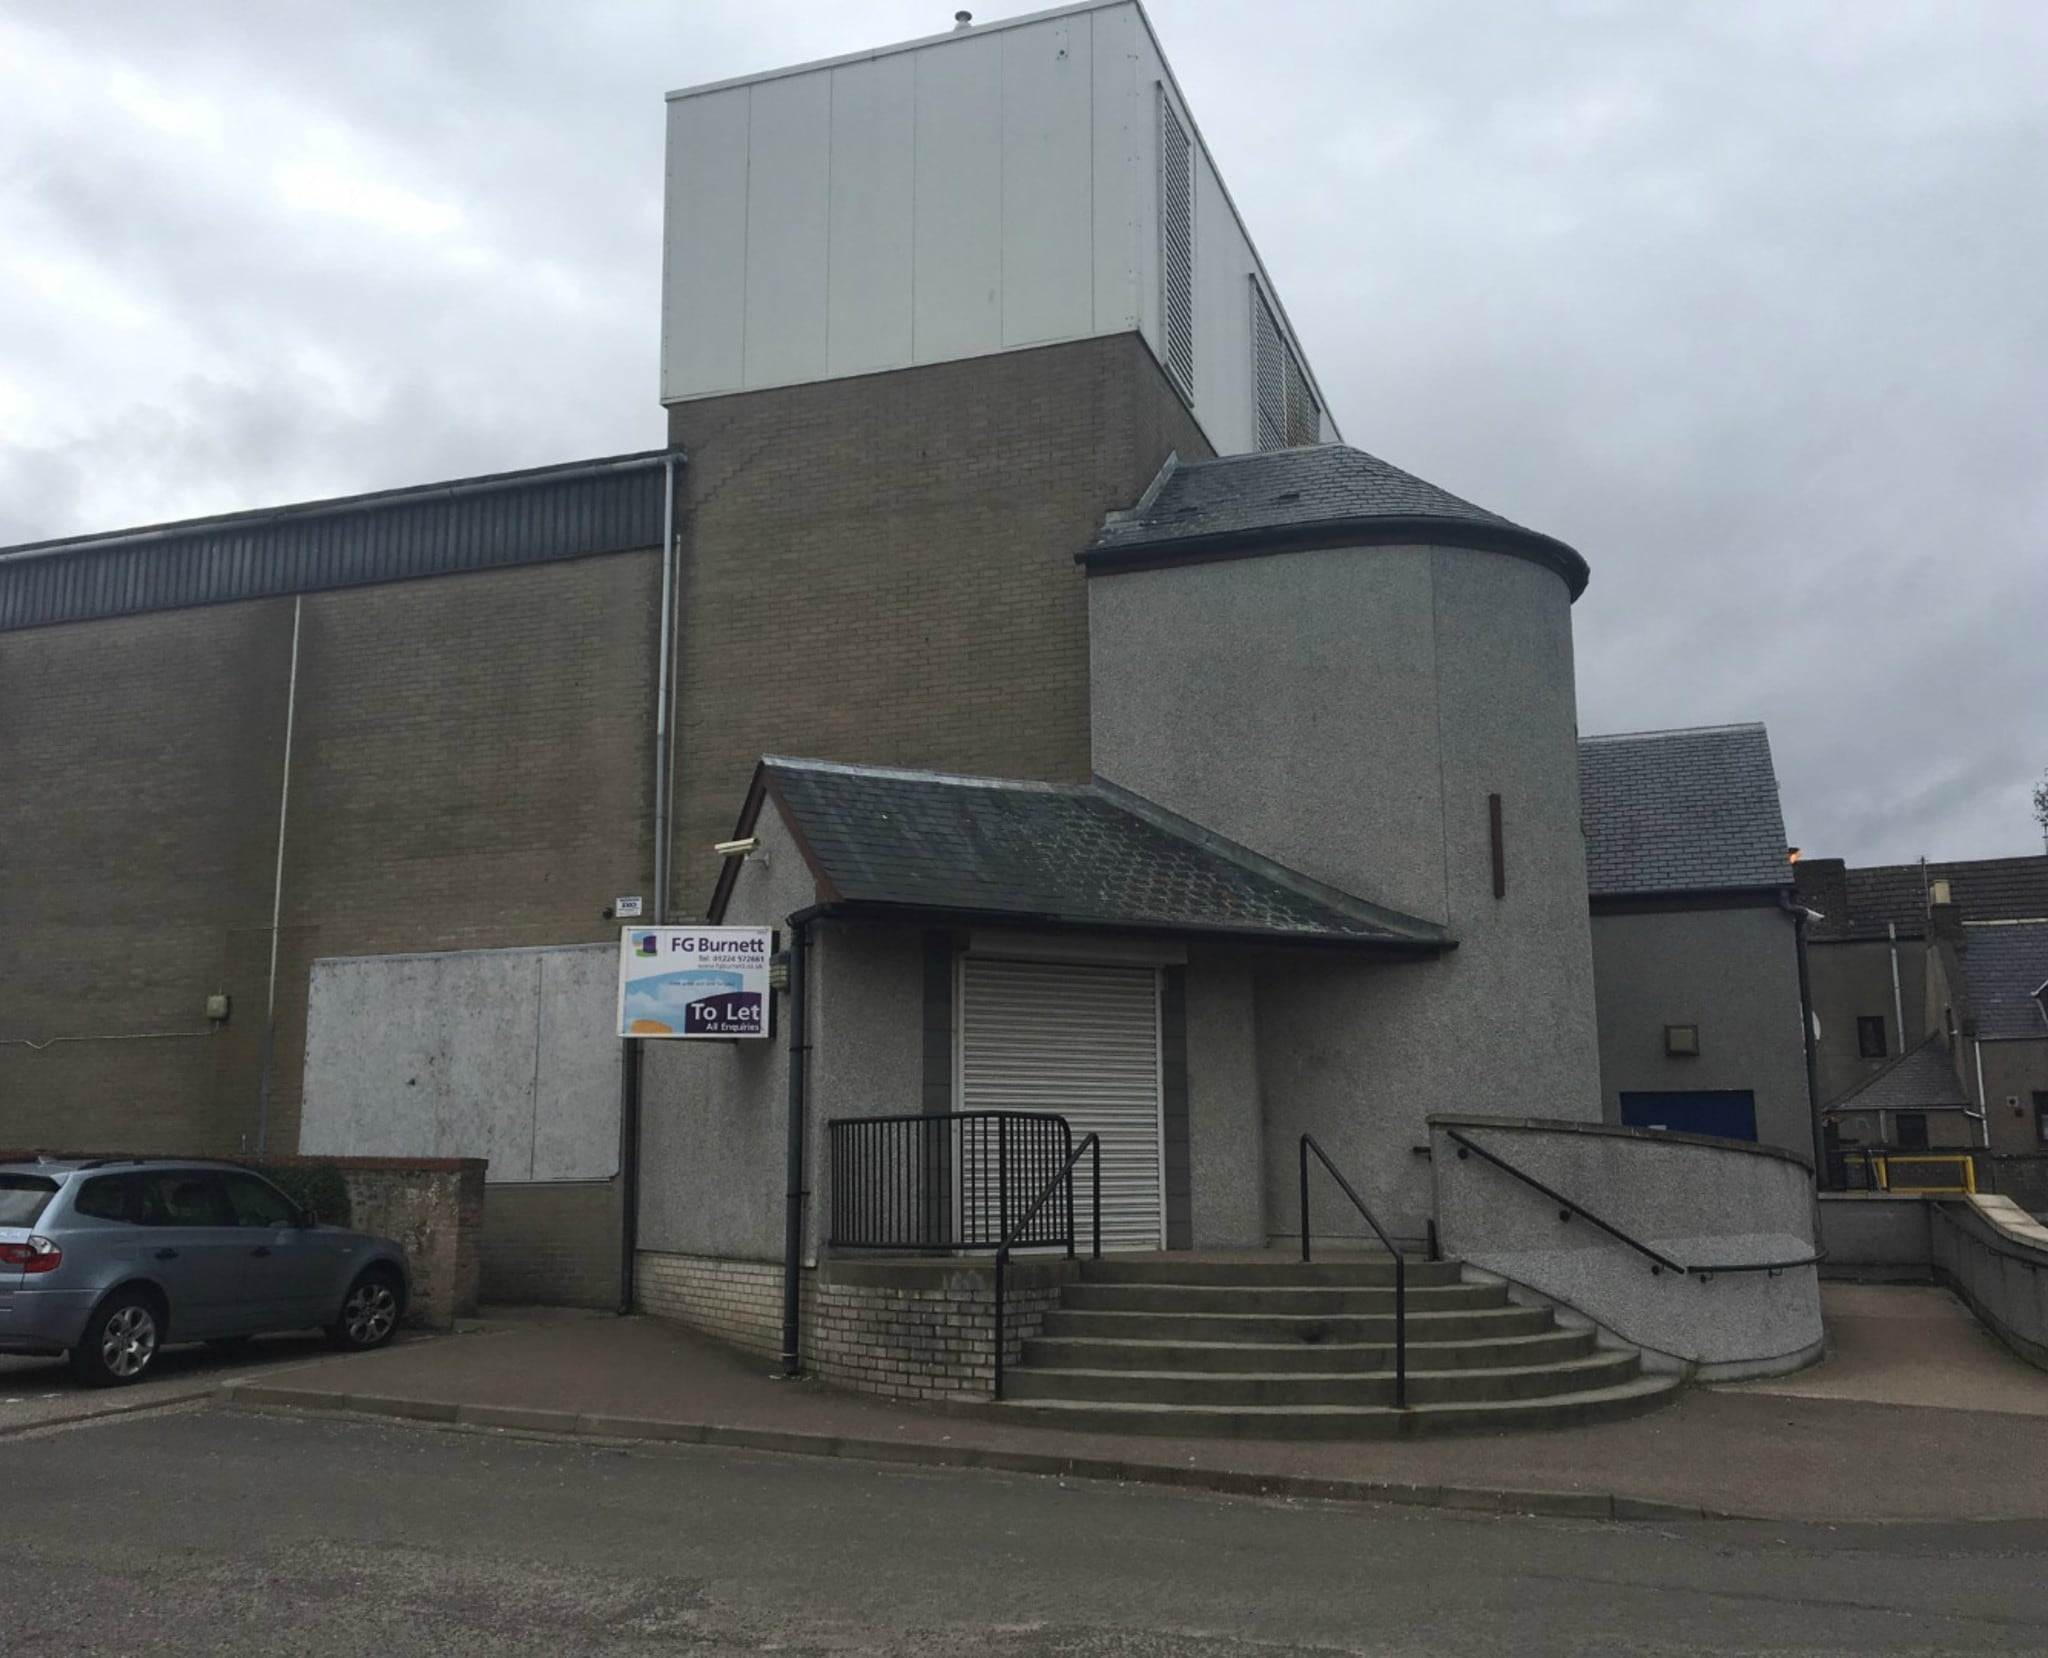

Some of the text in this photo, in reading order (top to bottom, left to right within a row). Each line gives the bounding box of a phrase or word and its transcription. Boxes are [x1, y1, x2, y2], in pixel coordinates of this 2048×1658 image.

[671, 937, 764, 953] FG Burnett
[691, 1003, 760, 1021] To Let
[705, 1023, 760, 1032] All Enquiries
